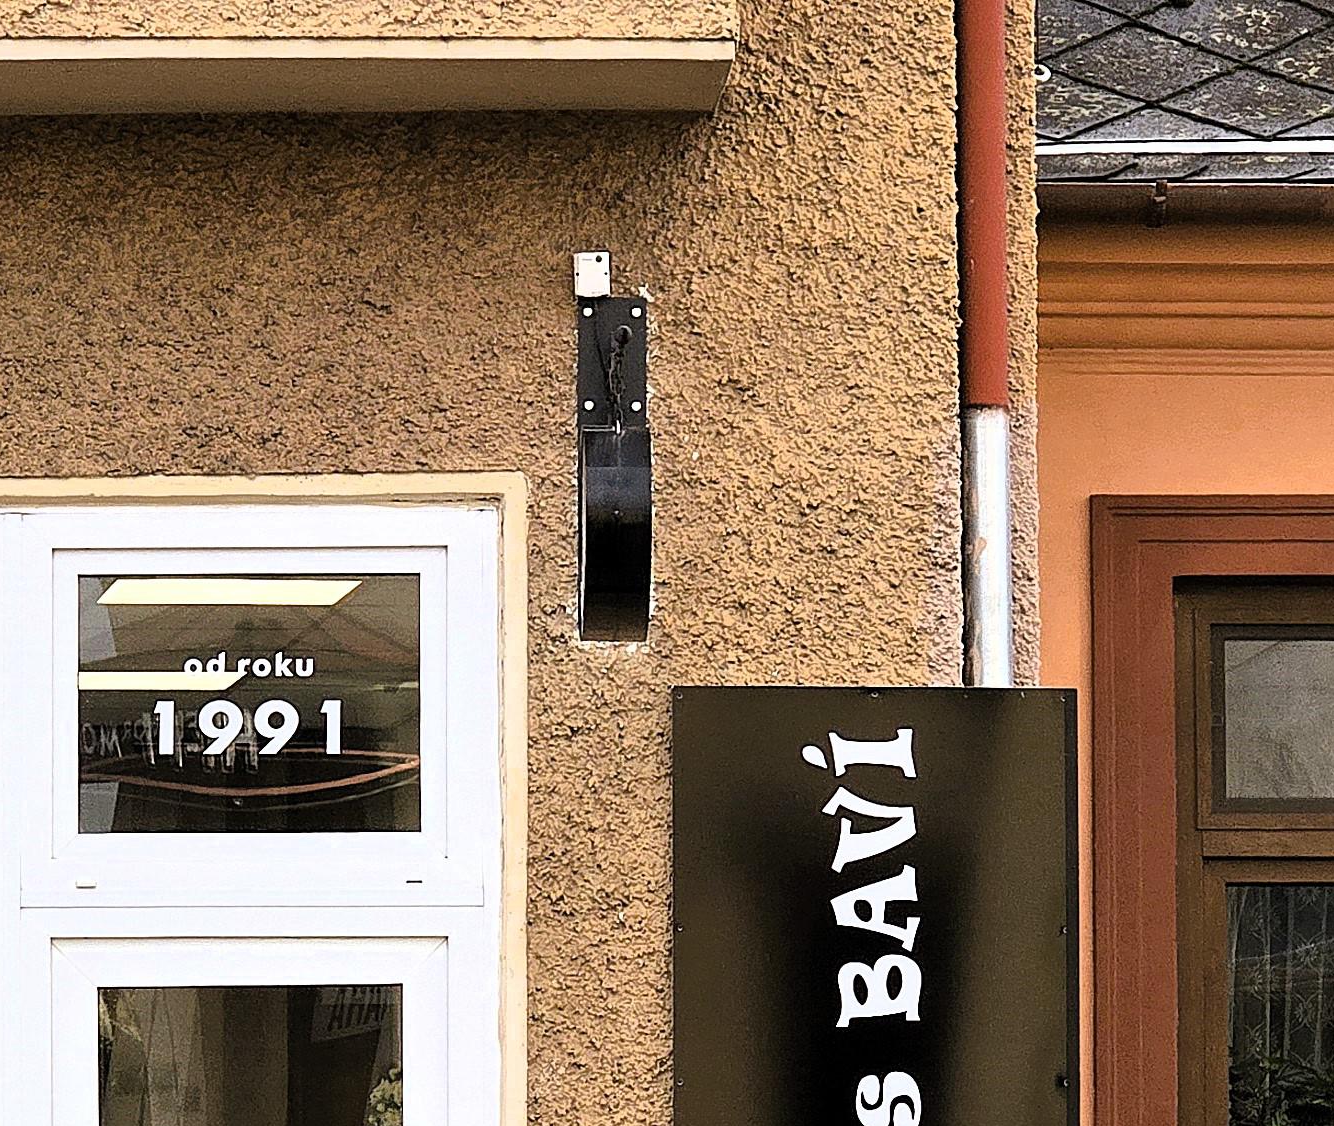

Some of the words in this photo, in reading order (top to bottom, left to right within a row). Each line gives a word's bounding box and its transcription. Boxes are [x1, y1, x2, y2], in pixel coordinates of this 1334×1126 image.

[183, 651, 226, 676] od
[237, 651, 314, 677] roku
[153, 700, 343, 755] 1991
[802, 728, 921, 1028] BAVÍ
